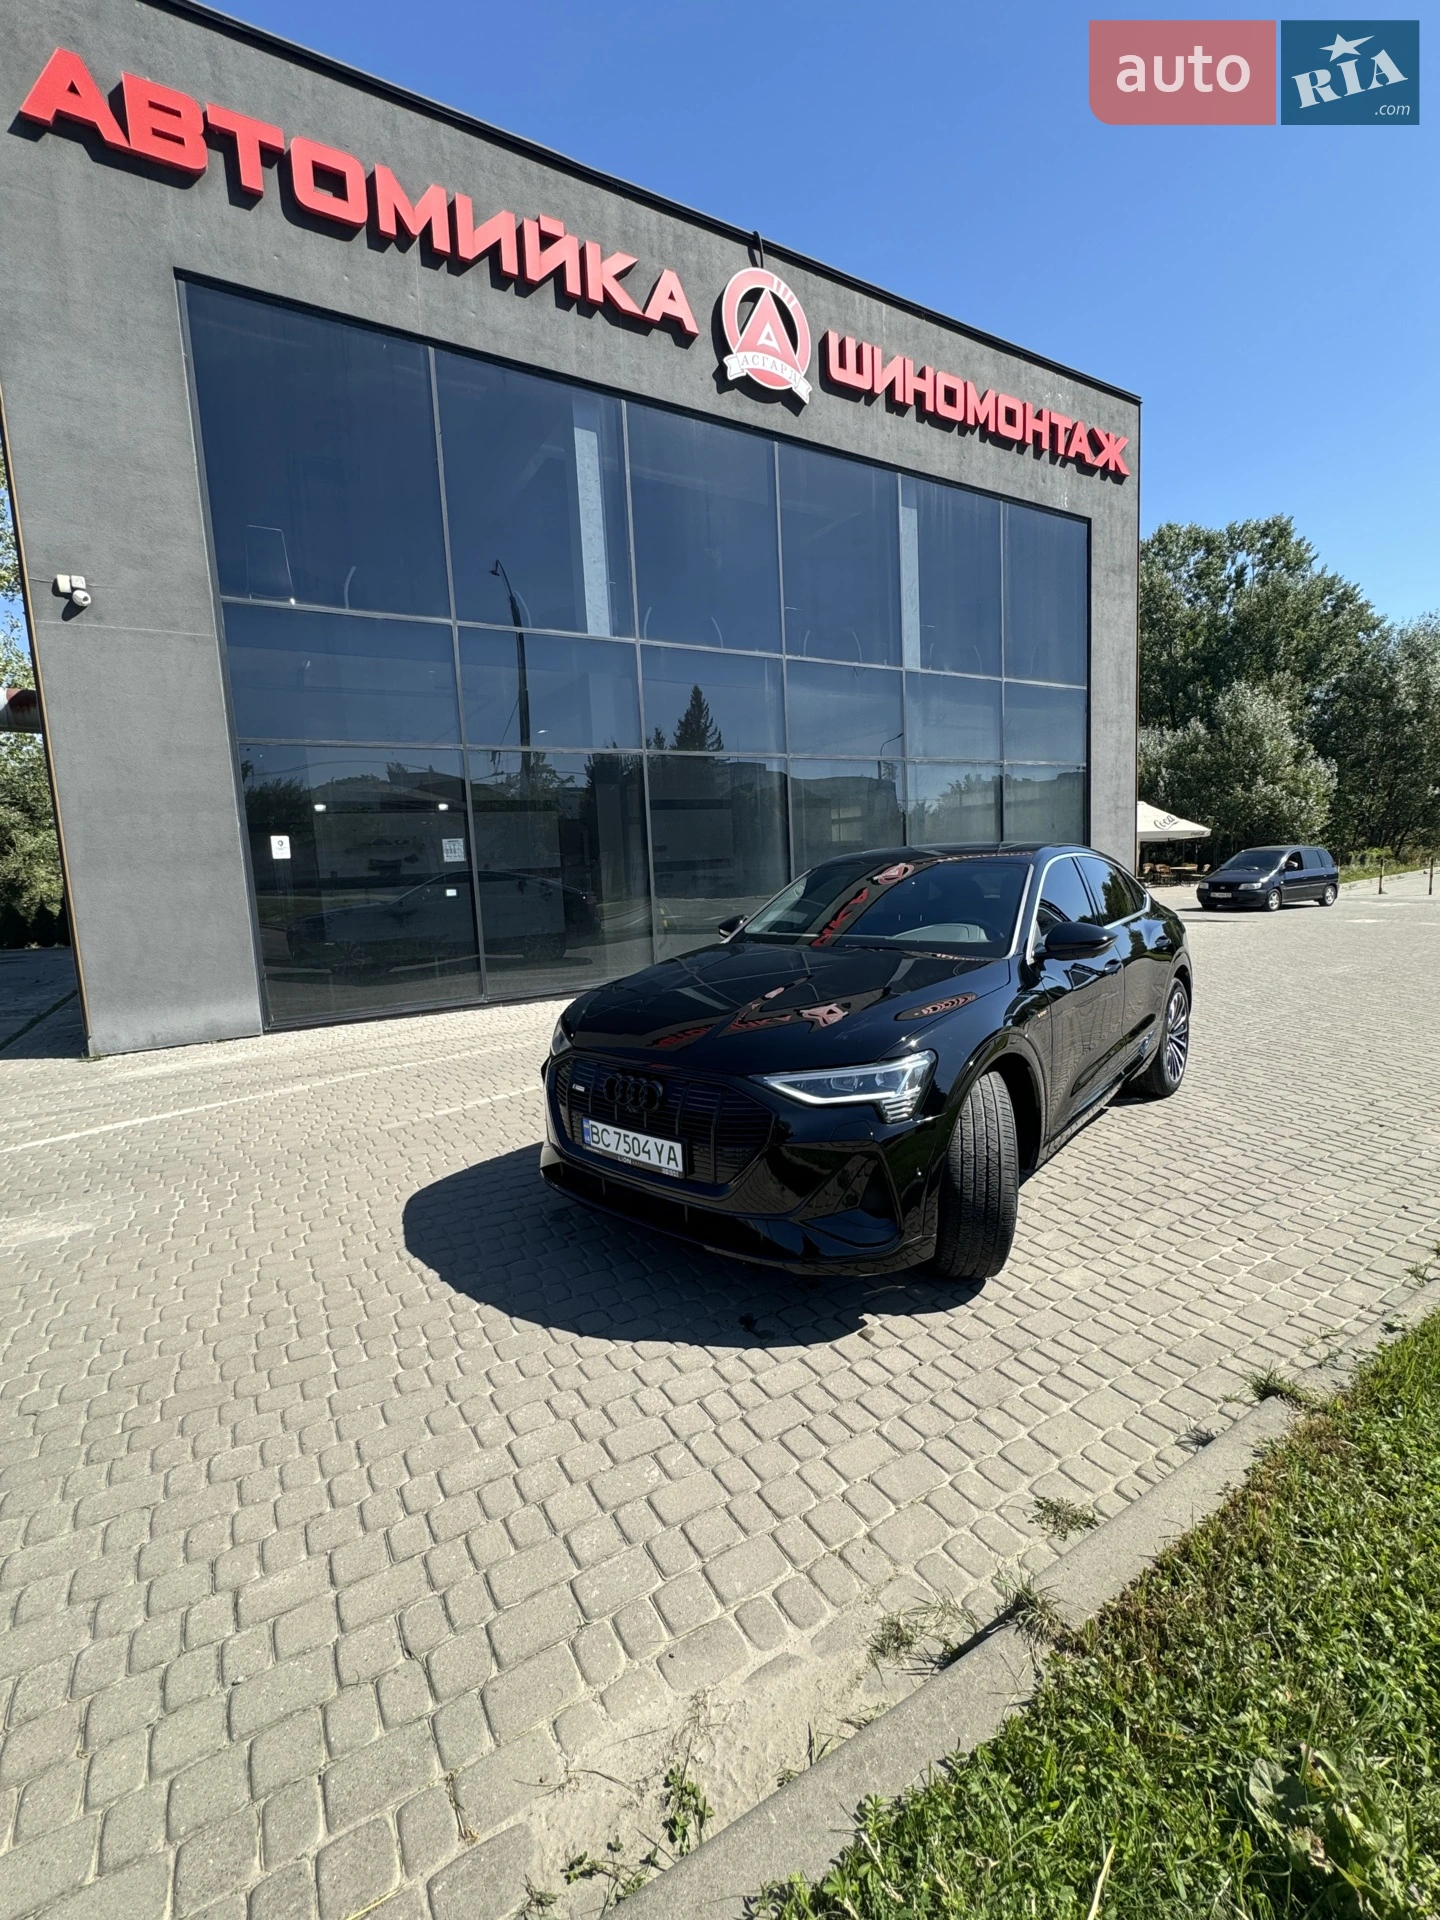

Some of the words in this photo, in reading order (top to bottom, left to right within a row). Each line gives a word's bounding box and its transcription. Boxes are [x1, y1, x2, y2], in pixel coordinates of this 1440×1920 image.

[20, 47, 700, 337] АВТОМИЙКА
[741, 354, 798, 385] АСГАРД
[827, 329, 1130, 477] ШИНОМОНТАЖ
